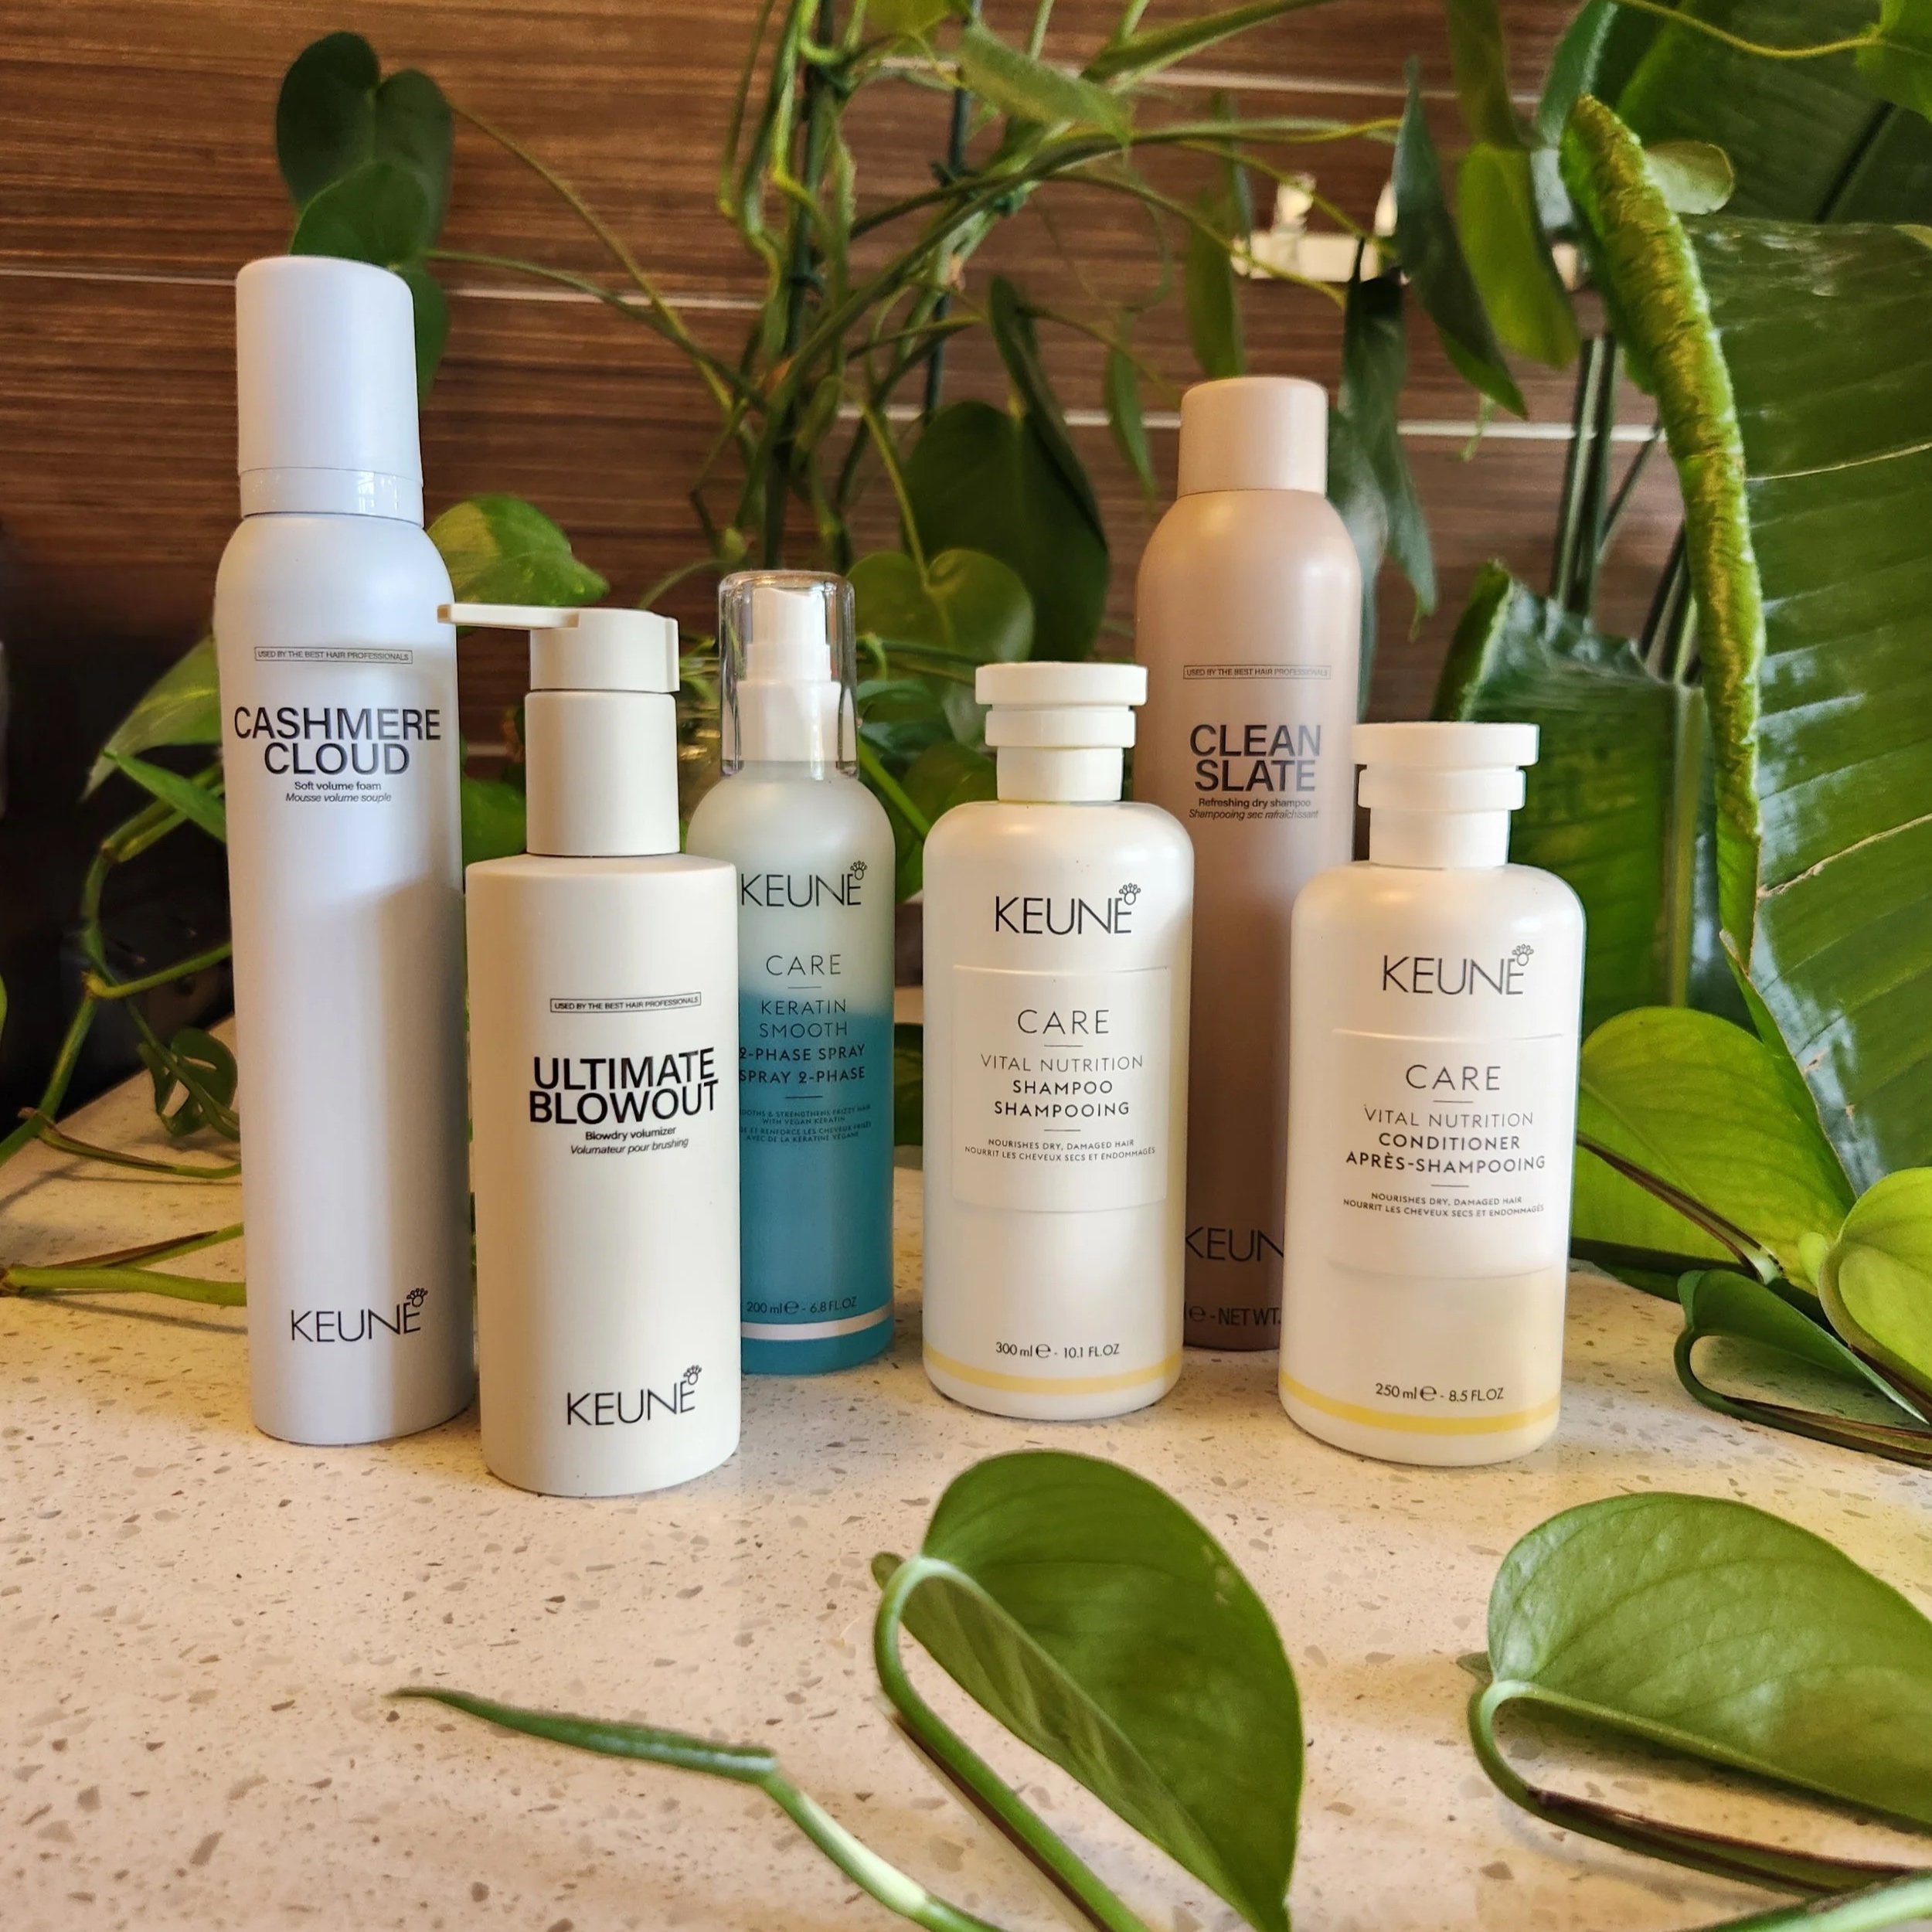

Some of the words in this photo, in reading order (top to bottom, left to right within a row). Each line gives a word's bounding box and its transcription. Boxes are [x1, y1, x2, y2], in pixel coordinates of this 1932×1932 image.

[348, 651, 410, 660] PROFESSIONALS
[234, 706, 441, 740] CASHMERE
[1189, 724, 1321, 757] CLEAN
[264, 742, 410, 775] CLOUD
[1195, 759, 1316, 792] SLATE
[294, 781, 314, 791] Soft
[316, 781, 354, 791] volume
[356, 781, 382, 791] foam
[285, 793, 321, 802] Mousse
[324, 793, 359, 802] volume
[361, 793, 392, 804] souple
[1199, 798, 1250, 809] Refreshing
[1252, 798, 1268, 809] dry
[1270, 798, 1311, 809] shampoo
[1189, 809, 1245, 821] Shampooing
[1247, 811, 1263, 820] sec
[741, 873, 862, 907] KEUNE
[995, 896, 1132, 935] KEUNE
[766, 954, 842, 975] CARE
[1383, 954, 1524, 995] KEUNE
[645, 997, 699, 1008] PROFESSIONALS
[761, 998, 846, 1015] KERATIN
[760, 1021, 847, 1038] SMOOTH
[1018, 1009, 1109, 1035] CARE
[818, 1044, 866, 1060] SPRAY
[534, 1047, 715, 1090] ULTIMATE
[981, 1053, 1031, 1072] VITAL
[1040, 1055, 1143, 1073] NUTRITION
[740, 1070, 791, 1084] SPRAY
[798, 1066, 866, 1084] 2-PHASE
[1406, 1064, 1501, 1090] CARE
[1012, 1080, 1113, 1095] SHAMPOO
[529, 1079, 719, 1125] BLOWOUT
[995, 1100, 1129, 1117] SHAMPOOING
[1363, 1106, 1420, 1126] VITAL
[1429, 1111, 1533, 1128] NUTRITION
[586, 1130, 628, 1141] Blowdry
[630, 1126, 676, 1138] volumizer
[1379, 1132, 1520, 1151] CONDITIONER
[570, 1144, 624, 1155] Volumateur
[628, 1145, 649, 1155] pour
[651, 1138, 689, 1151] brushing
[964, 1146, 999, 1157] NOURRIT
[988, 1139, 1039, 1149] NOURISHES
[1043, 1142, 1063, 1151] DRY,
[1066, 1141, 1112, 1150] DAMAGED
[1114, 1139, 1134, 1148] HAIR
[1345, 1151, 1546, 1173] APRÈS-SHAMPOOING
[1343, 1199, 1382, 1211] NOURRIT
[1386, 1206, 1400, 1214] LES
[1403, 1207, 1449, 1216] CHEVEUX
[1371, 1192, 1426, 1204] NOURISHES
[1454, 1197, 1499, 1206] DAMAGED
[1185, 1226, 1284, 1262] KEUN
[747, 1301, 767, 1314] 200
[1219, 1307, 1250, 1326] NET
[291, 1302, 422, 1342] KEUNE
[995, 1342, 1017, 1355] 300
[1064, 1347, 1083, 1359] 10.1
[1376, 1383, 1400, 1397] 250
[1449, 1389, 1468, 1403] 8.5
[567, 1380, 696, 1426] KEUNE
